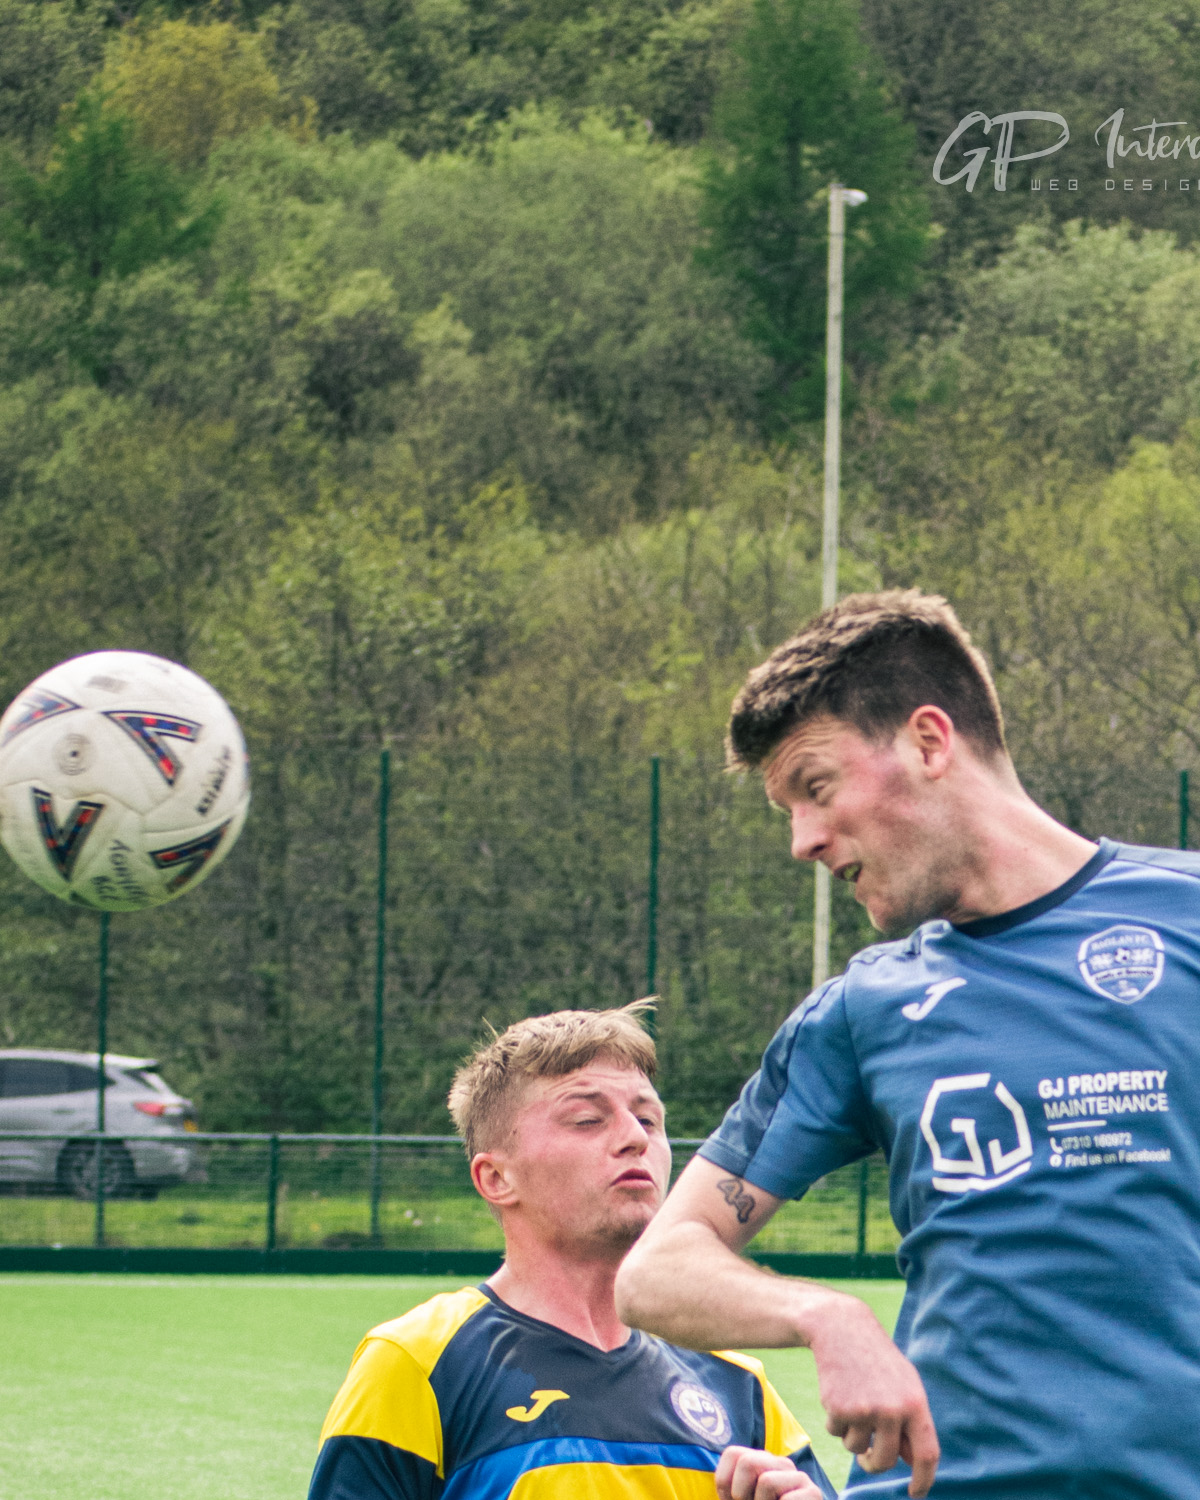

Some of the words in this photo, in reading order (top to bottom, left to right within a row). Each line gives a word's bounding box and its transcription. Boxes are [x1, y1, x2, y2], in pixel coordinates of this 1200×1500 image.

[1038, 1077, 1064, 1099] GJ
[1067, 1070, 1168, 1096] PROPERTY
[1043, 1092, 1169, 1120] MAINTENANCE
[1065, 1152, 1088, 1168] Find
[1088, 1153, 1102, 1166] us
[1103, 1153, 1117, 1165] on
